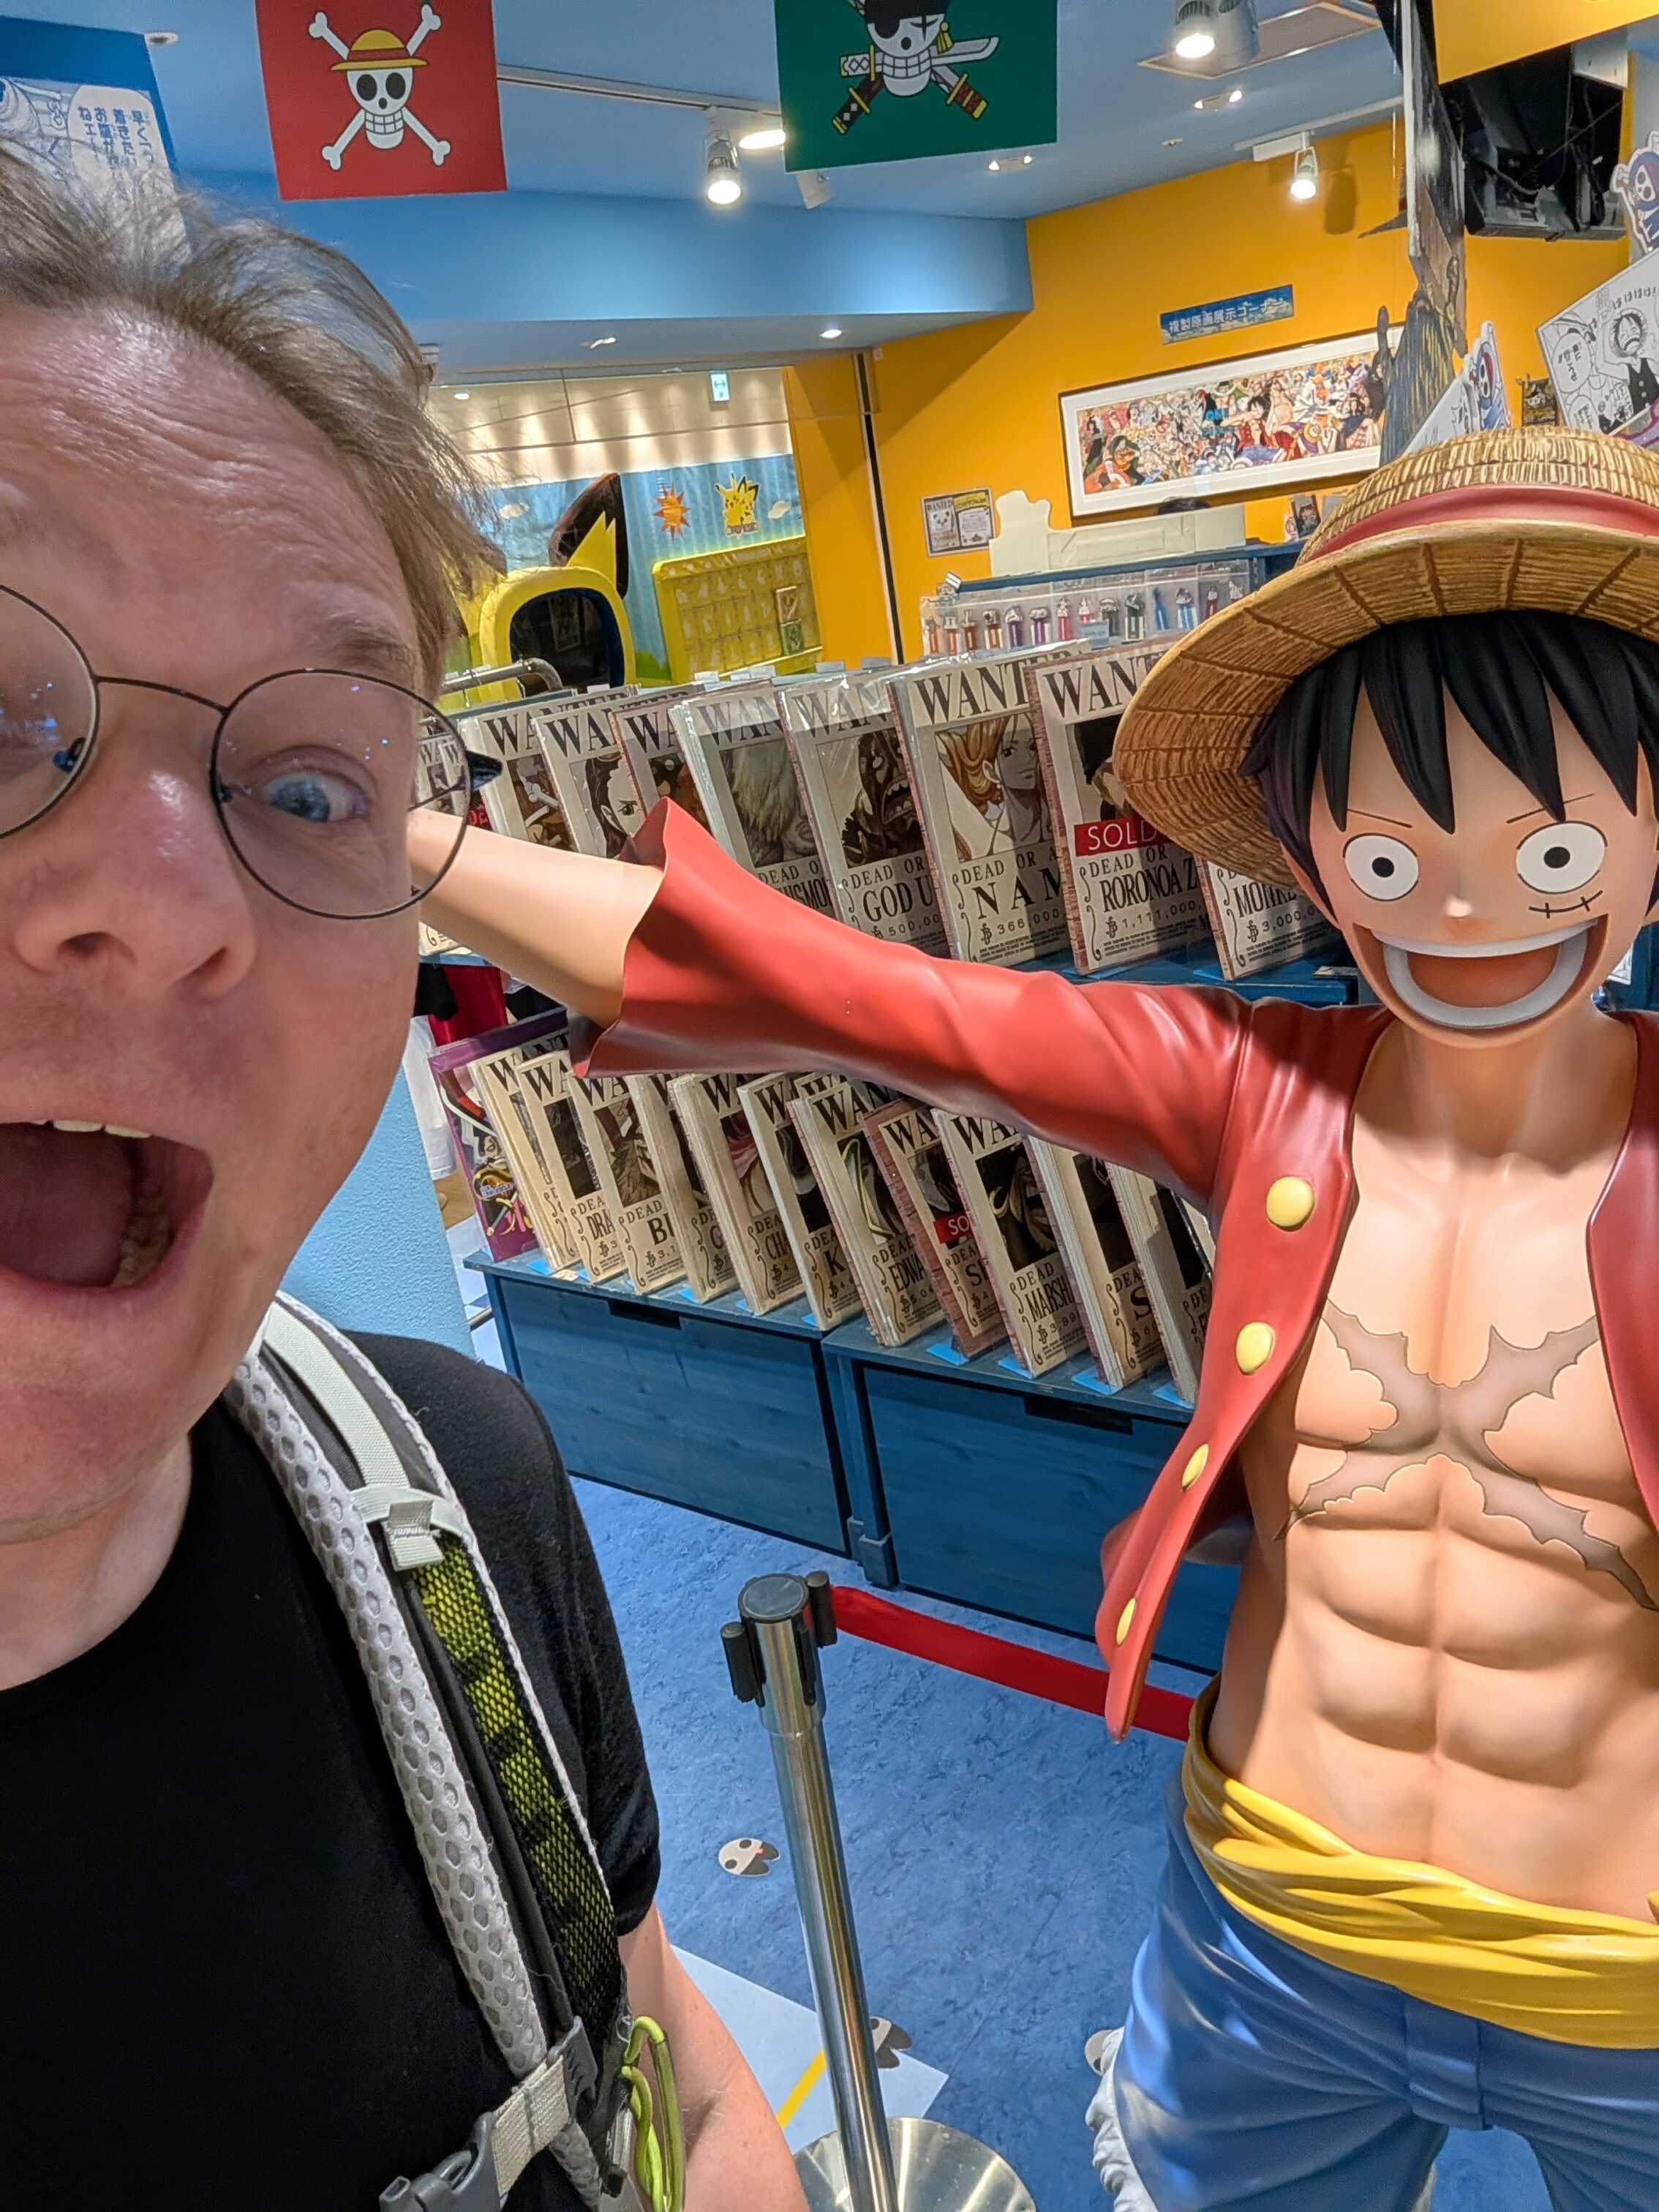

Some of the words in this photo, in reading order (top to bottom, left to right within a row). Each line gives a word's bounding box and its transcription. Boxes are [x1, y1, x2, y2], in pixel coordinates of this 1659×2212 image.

[1168, 298, 1284, 334] 複製原画展示コーナー
[696, 696, 784, 746] WAN
[792, 682, 888, 738] WAN
[1088, 819, 1157, 851] SOLD
[850, 864, 894, 889] DEAD
[903, 855, 925, 874] OR
[960, 859, 1005, 885] DEAD
[1015, 850, 1037, 870] OR
[1088, 852, 1134, 878] DEAD
[1146, 845, 1168, 863] OR
[862, 881, 914, 922] GOD
[1099, 863, 1184, 913] RORONOA
[576, 1195, 606, 1216] DEA
[625, 1200, 663, 1224] DEAD
[585, 1208, 617, 1241] DRA
[754, 1212, 783, 1235] DEA
[810, 1229, 838, 1251] DEA
[947, 1215, 971, 1235] SO
[951, 1244, 977, 1266] DEA
[887, 1252, 928, 1293] EDWA
[1016, 1261, 1054, 1291] DEAD
[1112, 1268, 1142, 1293] DEA
[1025, 1275, 1076, 1323] MARSH
